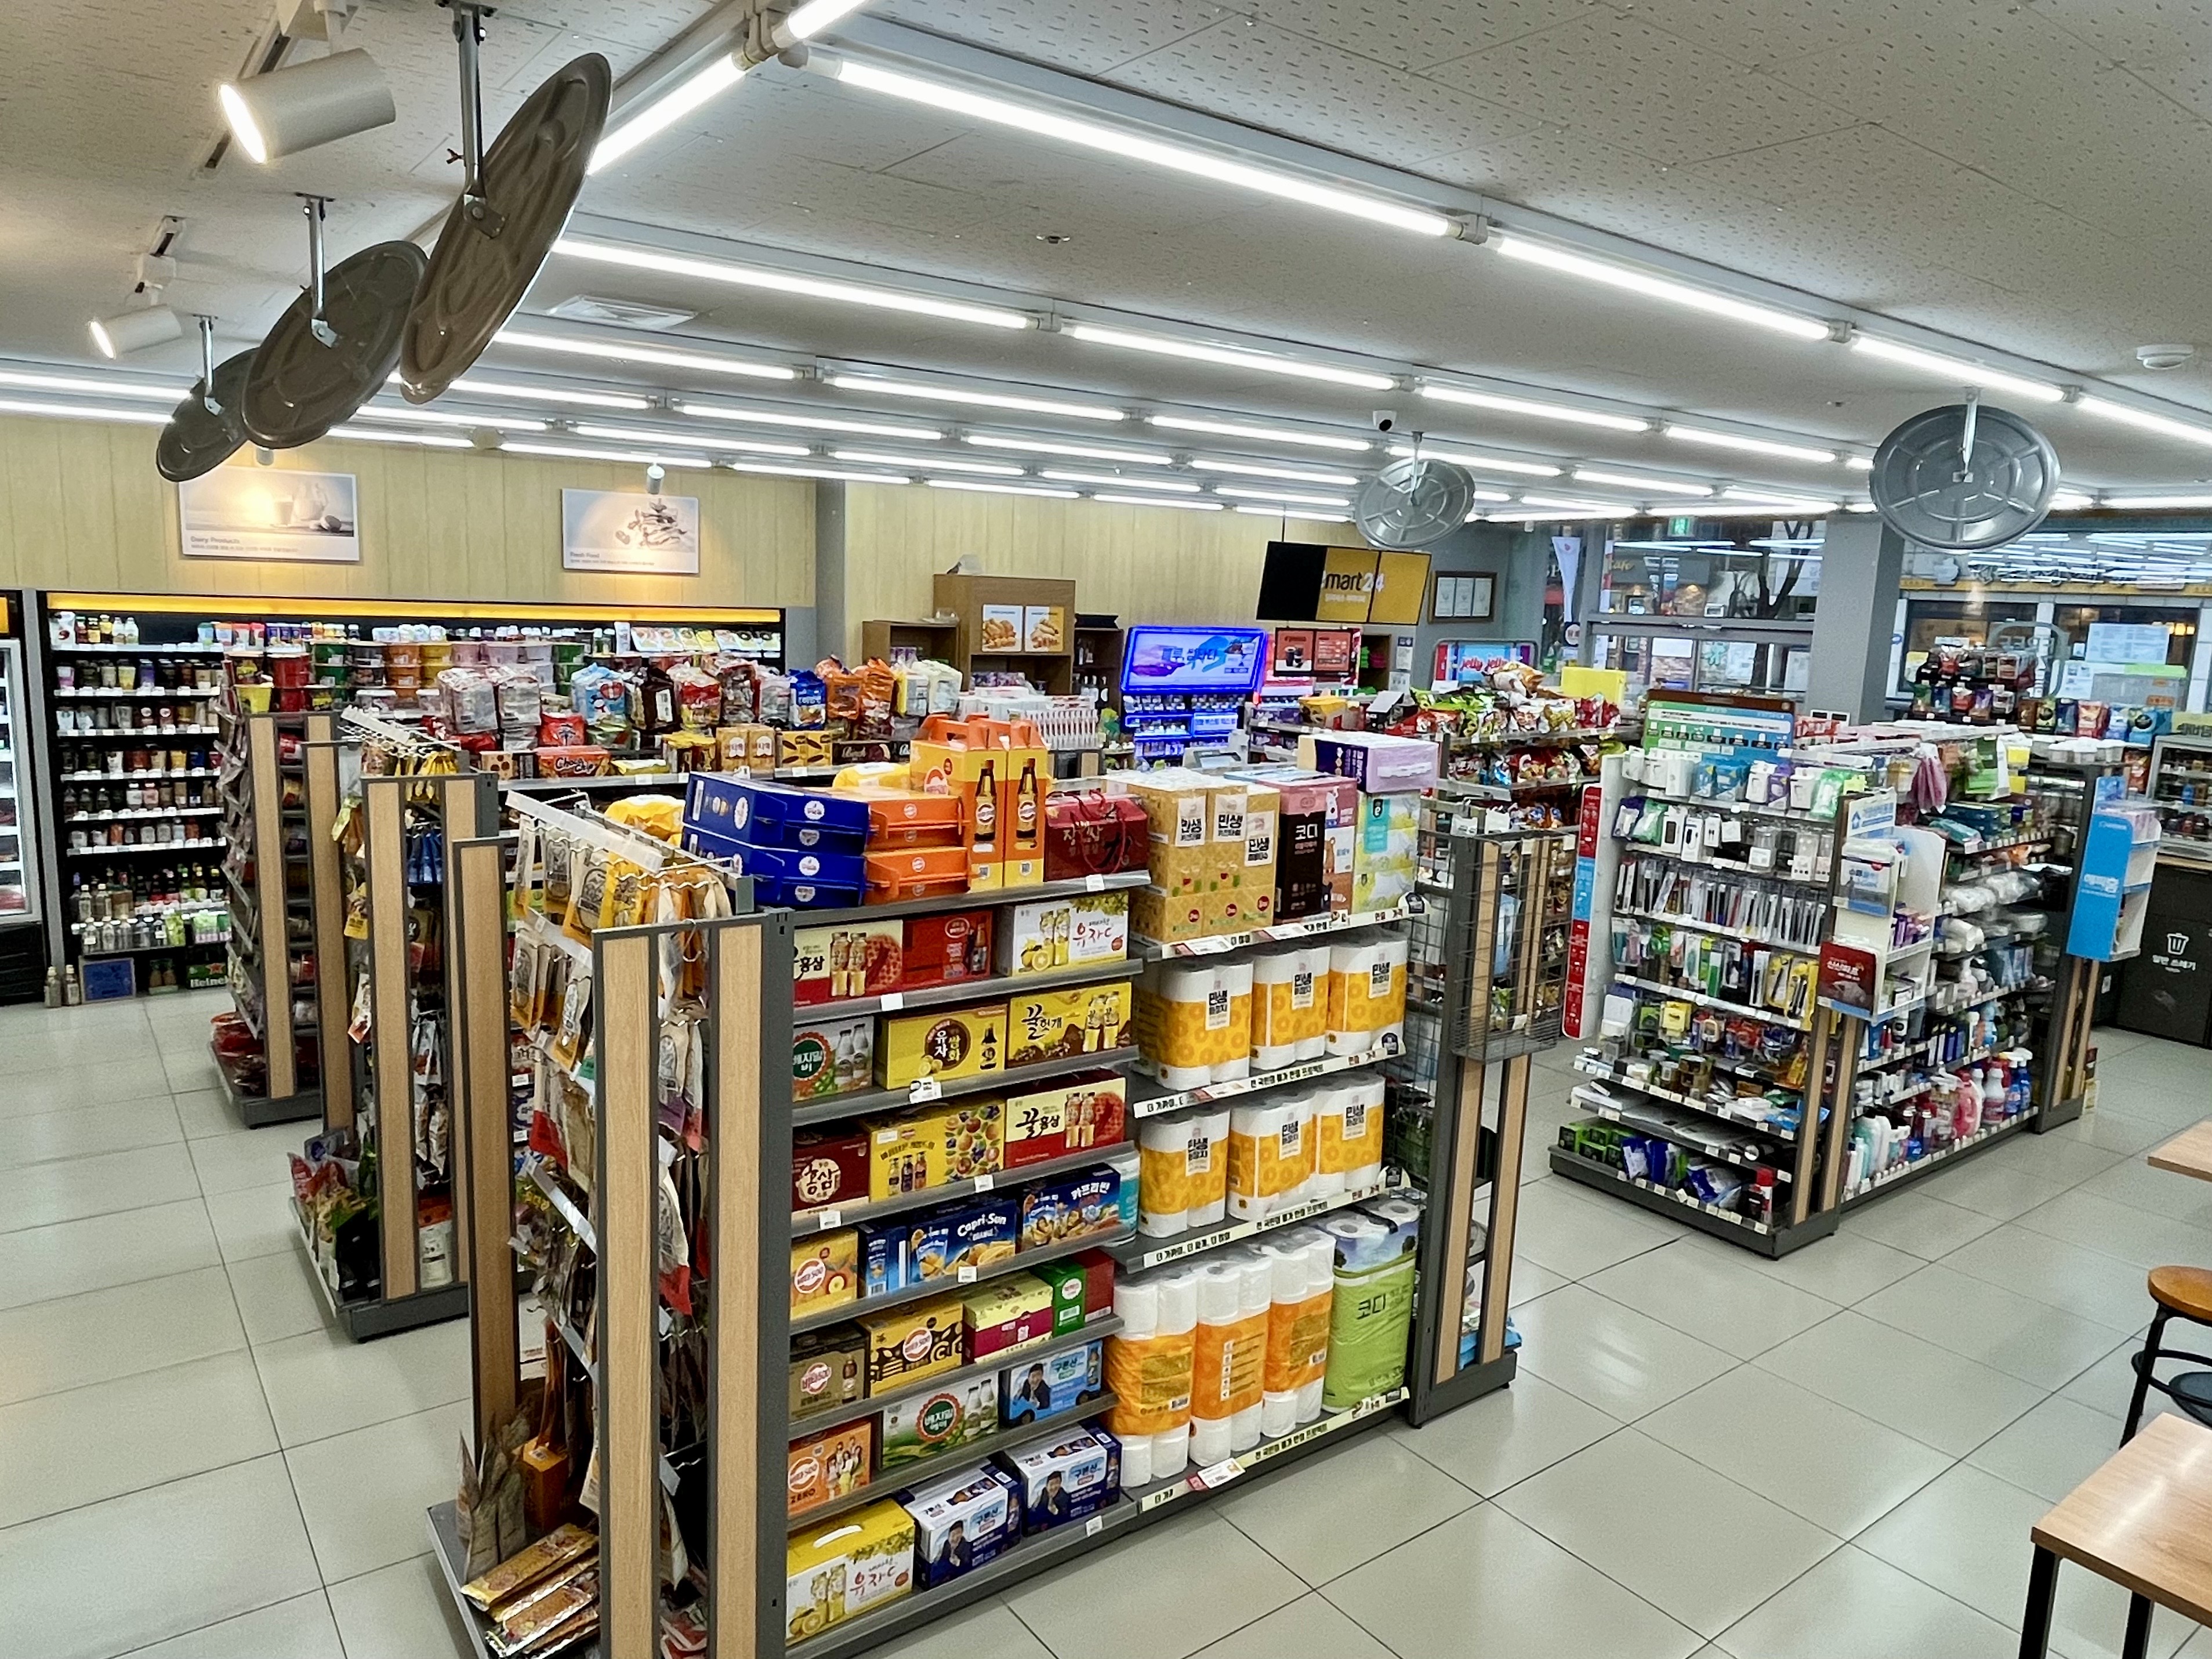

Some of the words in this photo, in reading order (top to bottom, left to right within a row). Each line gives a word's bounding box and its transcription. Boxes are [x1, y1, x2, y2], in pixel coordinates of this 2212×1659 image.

[1181, 818, 1202, 834] 민생
[1219, 814, 1243, 829] 민생
[1295, 824, 1318, 840] 코디
[1249, 837, 1270, 853] 민생
[1357, 1293, 1386, 1320] 코디
[790, 1487, 816, 1502] ZERO
